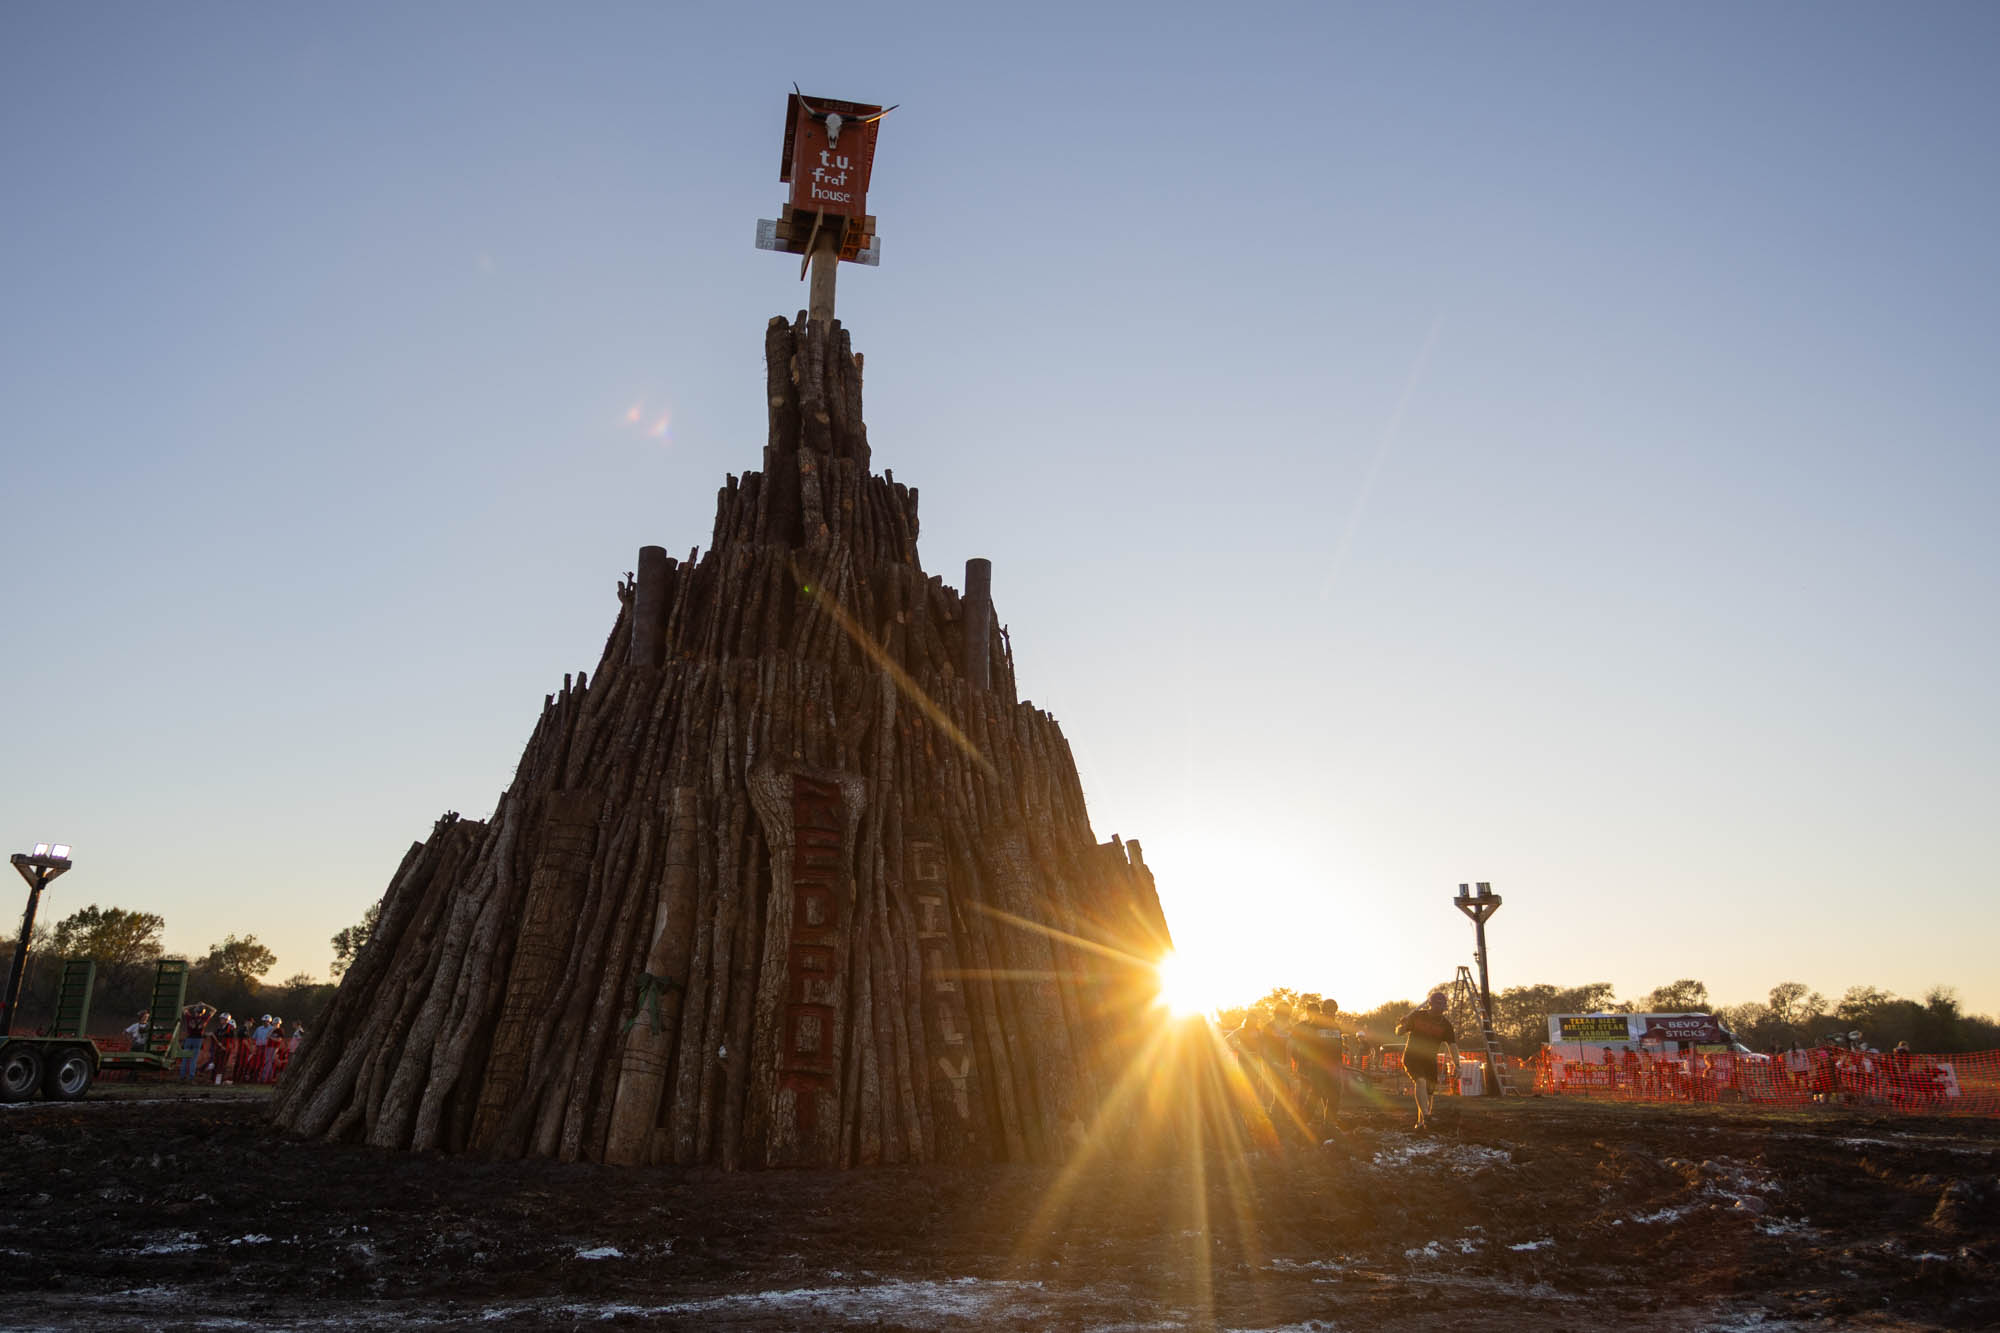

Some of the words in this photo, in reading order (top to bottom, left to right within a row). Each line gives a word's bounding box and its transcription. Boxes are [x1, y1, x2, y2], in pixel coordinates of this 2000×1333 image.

[811, 183, 851, 203] house
[1668, 1021, 1700, 1029] BEVO
[1665, 1029, 1705, 1038] STICKS
